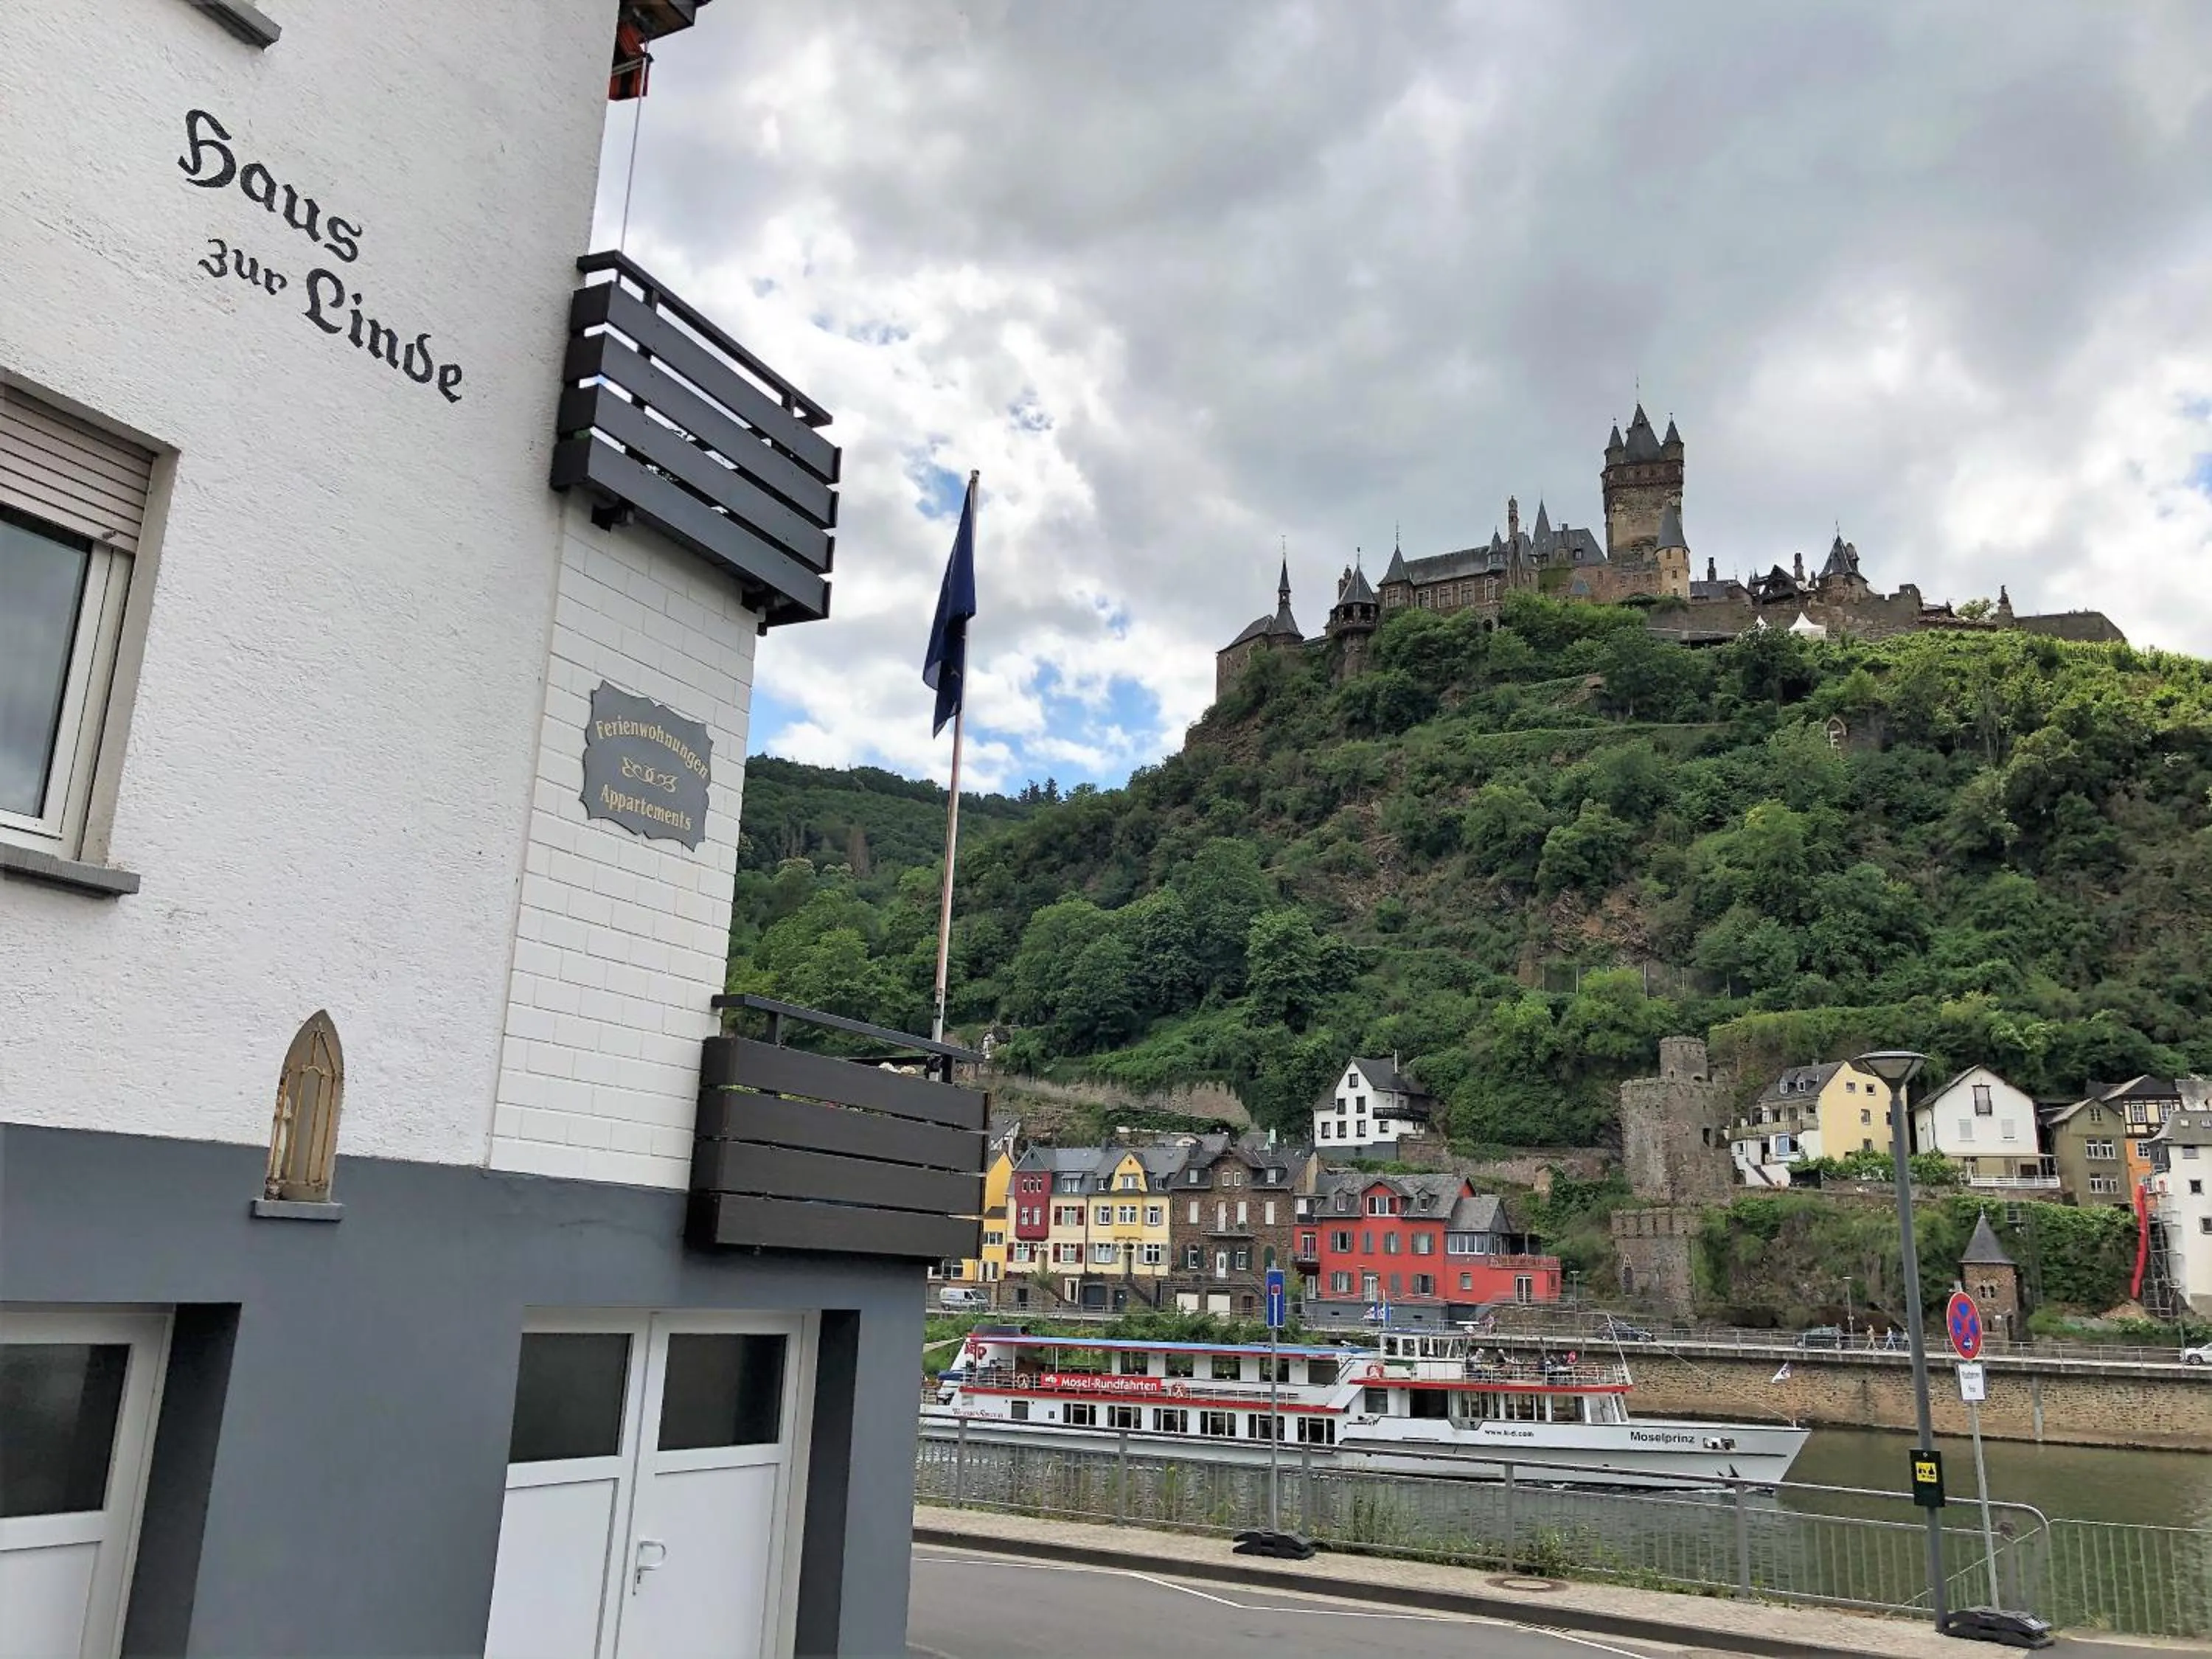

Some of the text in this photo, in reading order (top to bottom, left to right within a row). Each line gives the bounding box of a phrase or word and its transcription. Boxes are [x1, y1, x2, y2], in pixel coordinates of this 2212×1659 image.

[177, 108, 363, 263] Haus
[198, 238, 463, 403] zur Linde
[595, 714, 709, 779] Ferienwohnungen
[599, 784, 692, 832] Appartements
[1061, 1376, 1158, 1391] Mosel-Rundfahrten
[1630, 1431, 1695, 1444] Moselprinz
